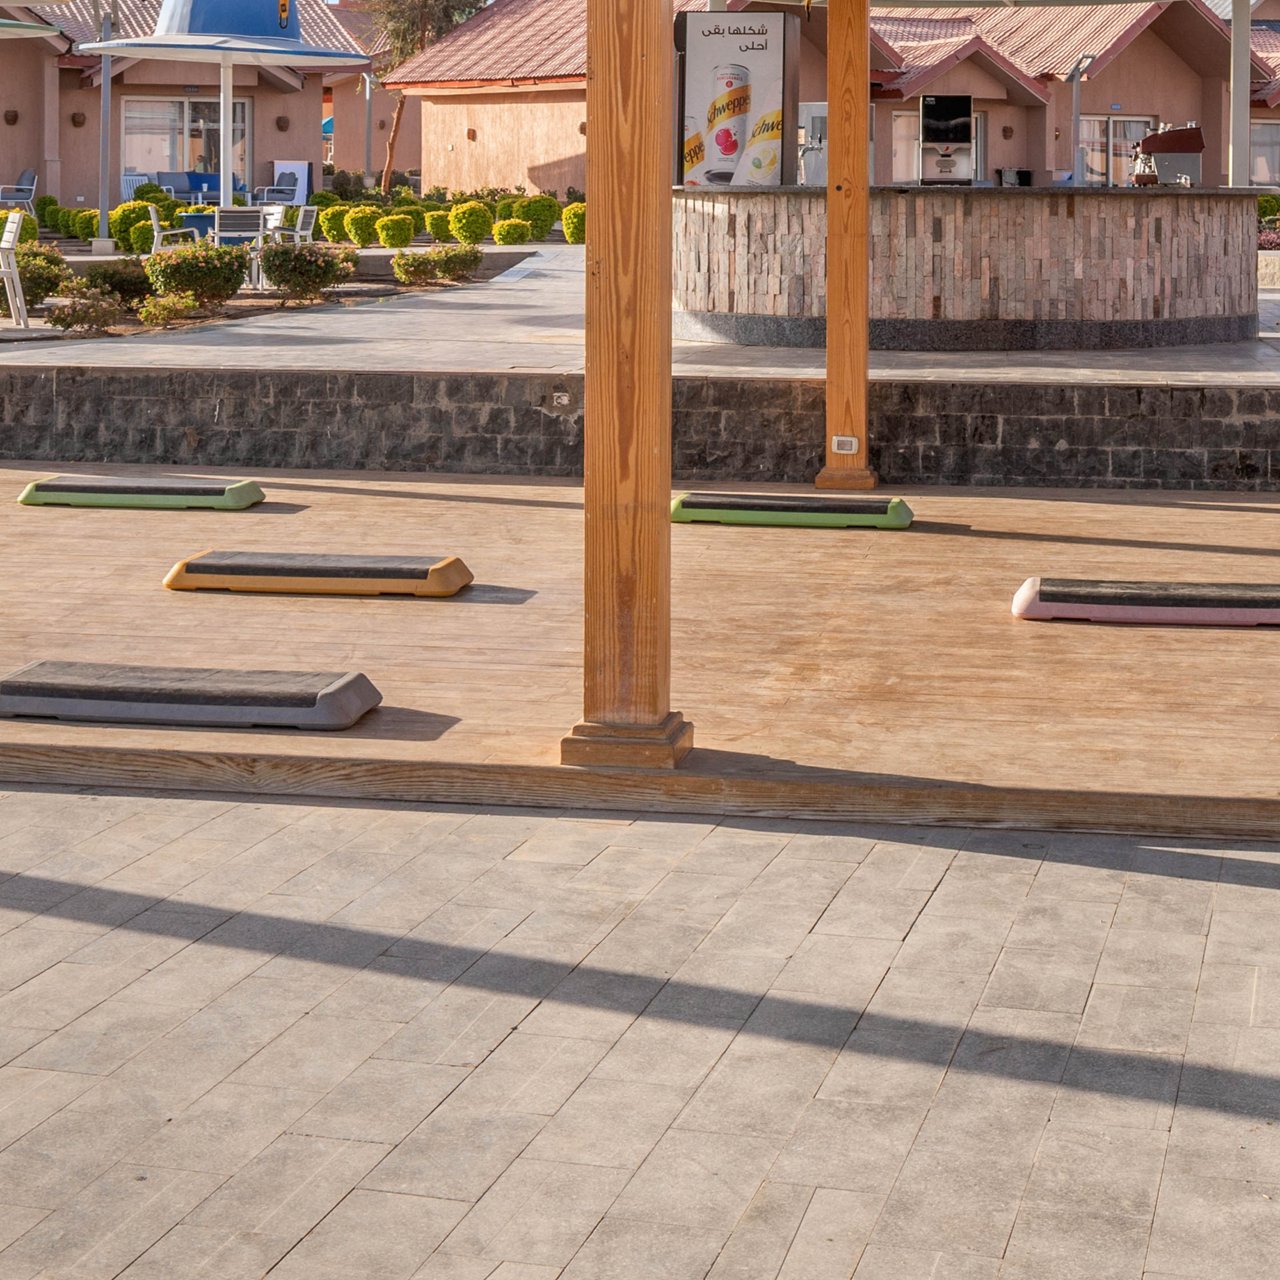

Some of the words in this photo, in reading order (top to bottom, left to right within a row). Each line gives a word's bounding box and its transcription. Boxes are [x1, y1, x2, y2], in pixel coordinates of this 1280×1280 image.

[702, 25, 725, 37] بقى
[728, 24, 768, 35] شكلها
[739, 39, 768, 52] أحلى
[707, 94, 751, 128] Schweppe
